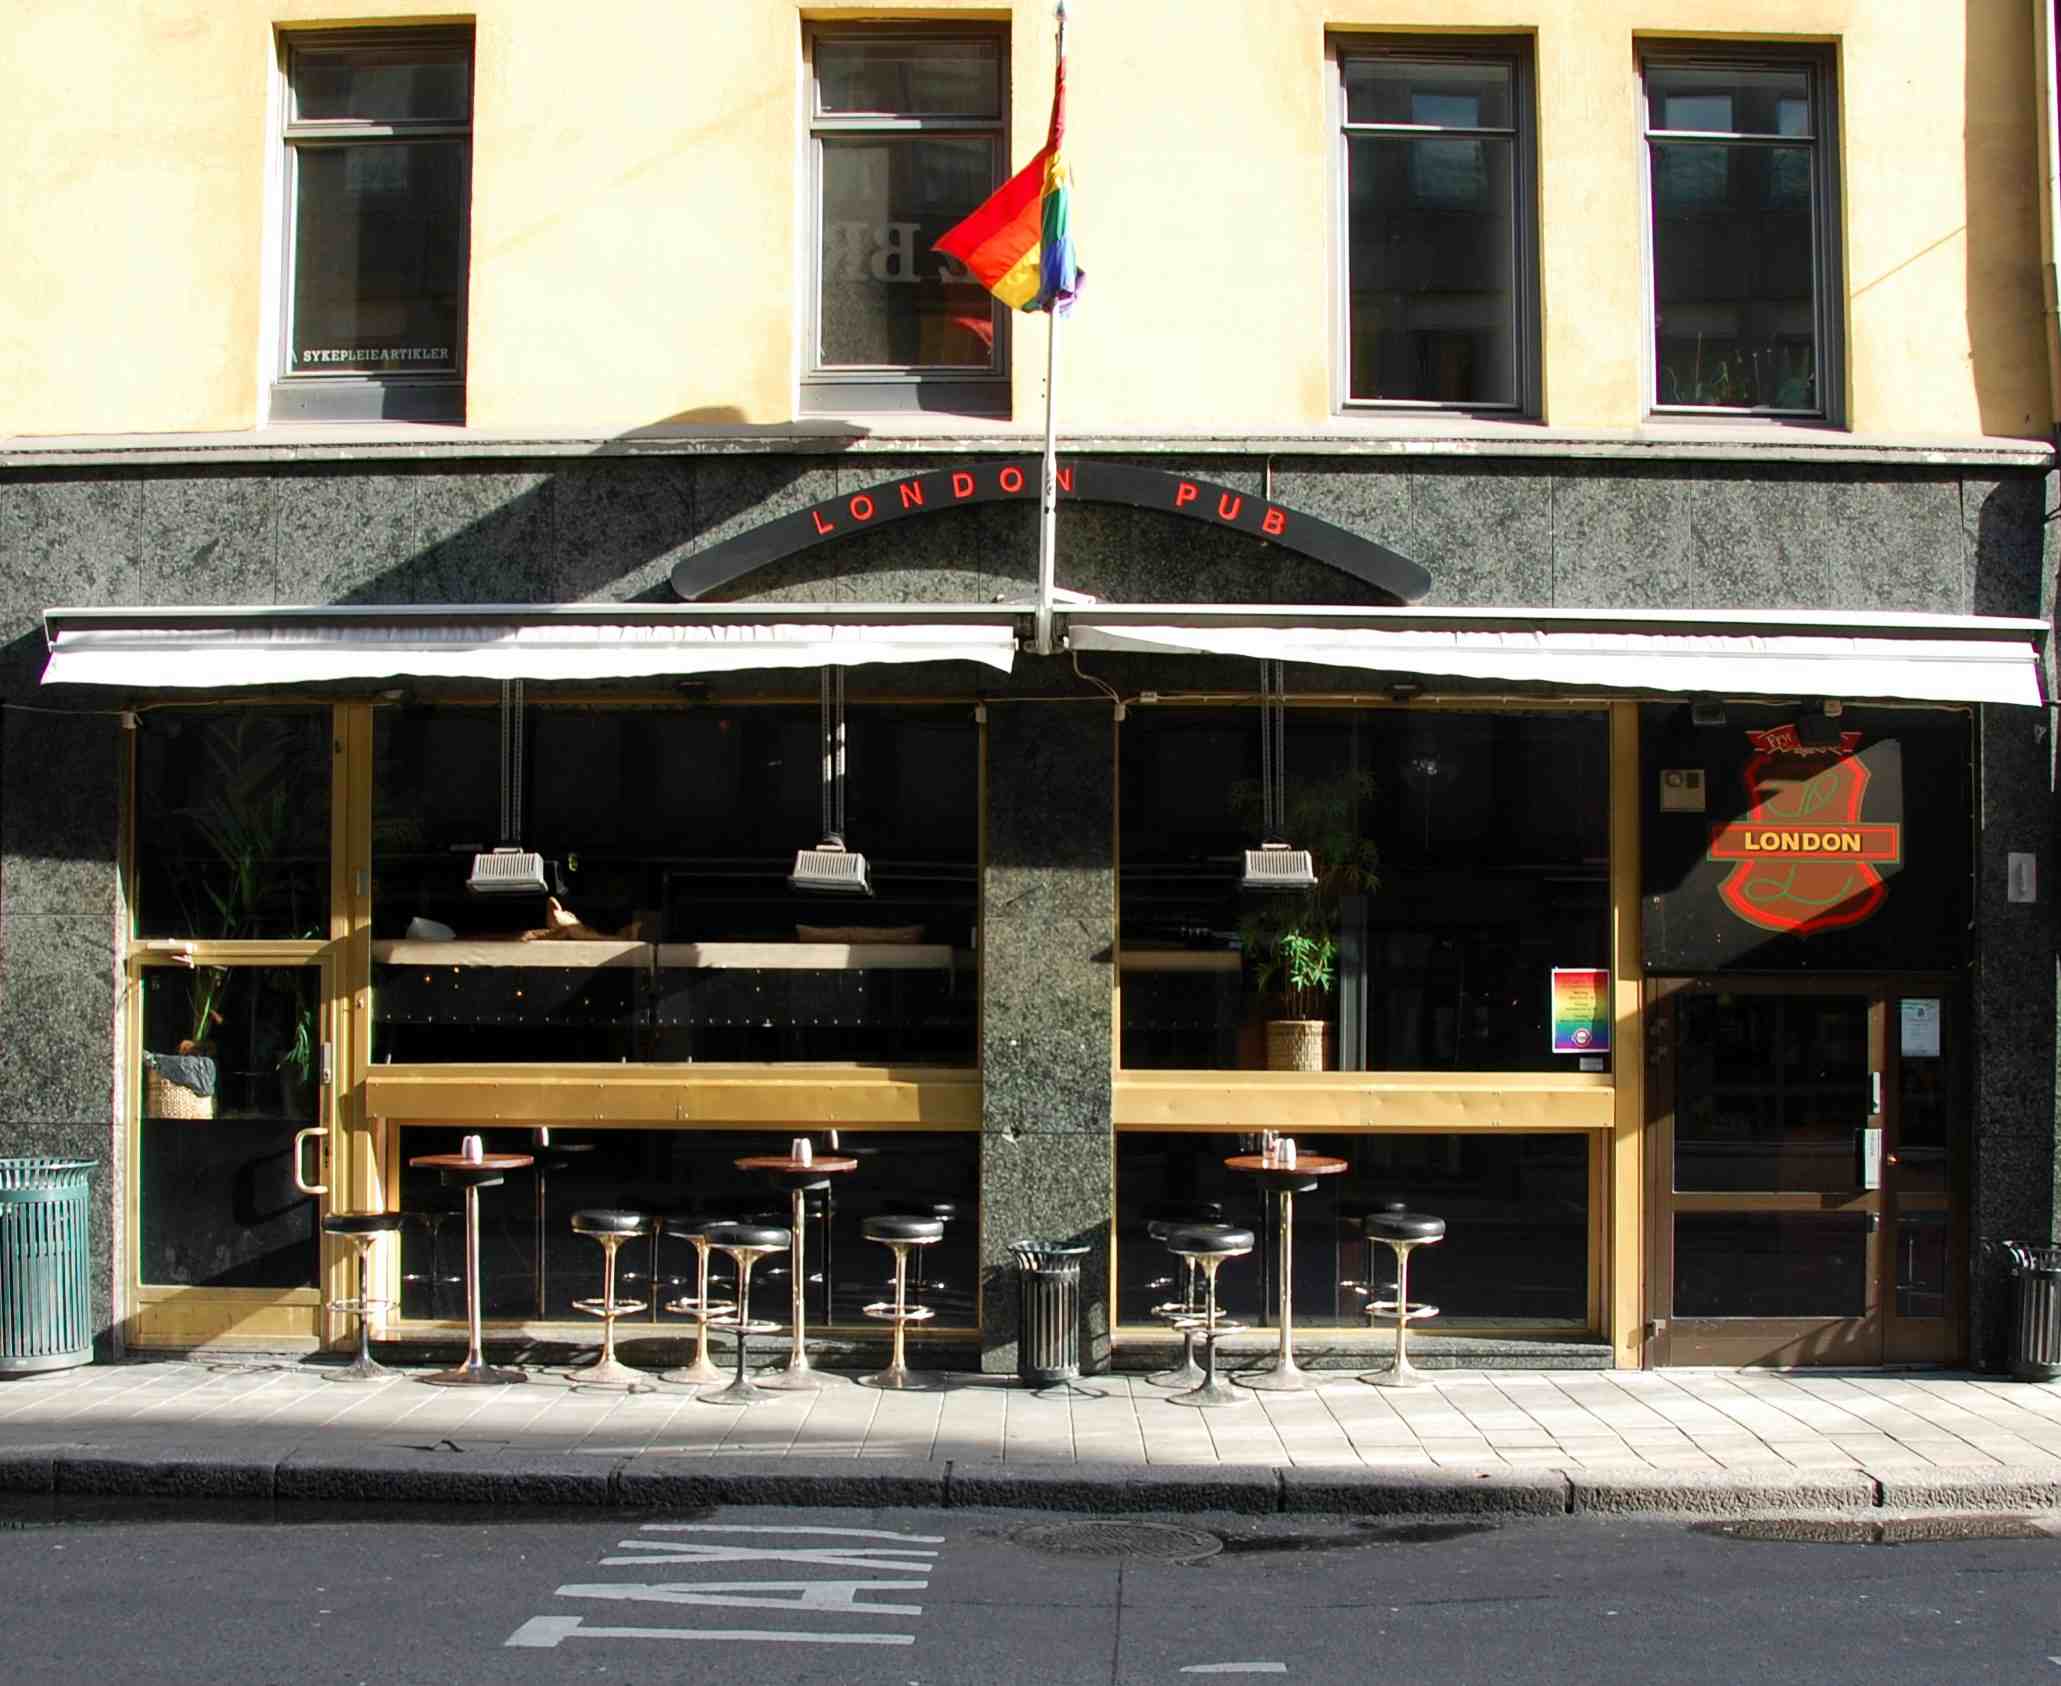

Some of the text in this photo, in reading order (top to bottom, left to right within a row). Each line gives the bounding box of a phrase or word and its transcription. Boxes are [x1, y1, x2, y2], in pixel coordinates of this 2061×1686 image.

[303, 348, 449, 362] SYKEPLEIEARTIKLER
[813, 467, 1286, 535] LONDON PUB
[1745, 832, 1861, 852] LONDON
[503, 1524, 946, 1647] TAXI
